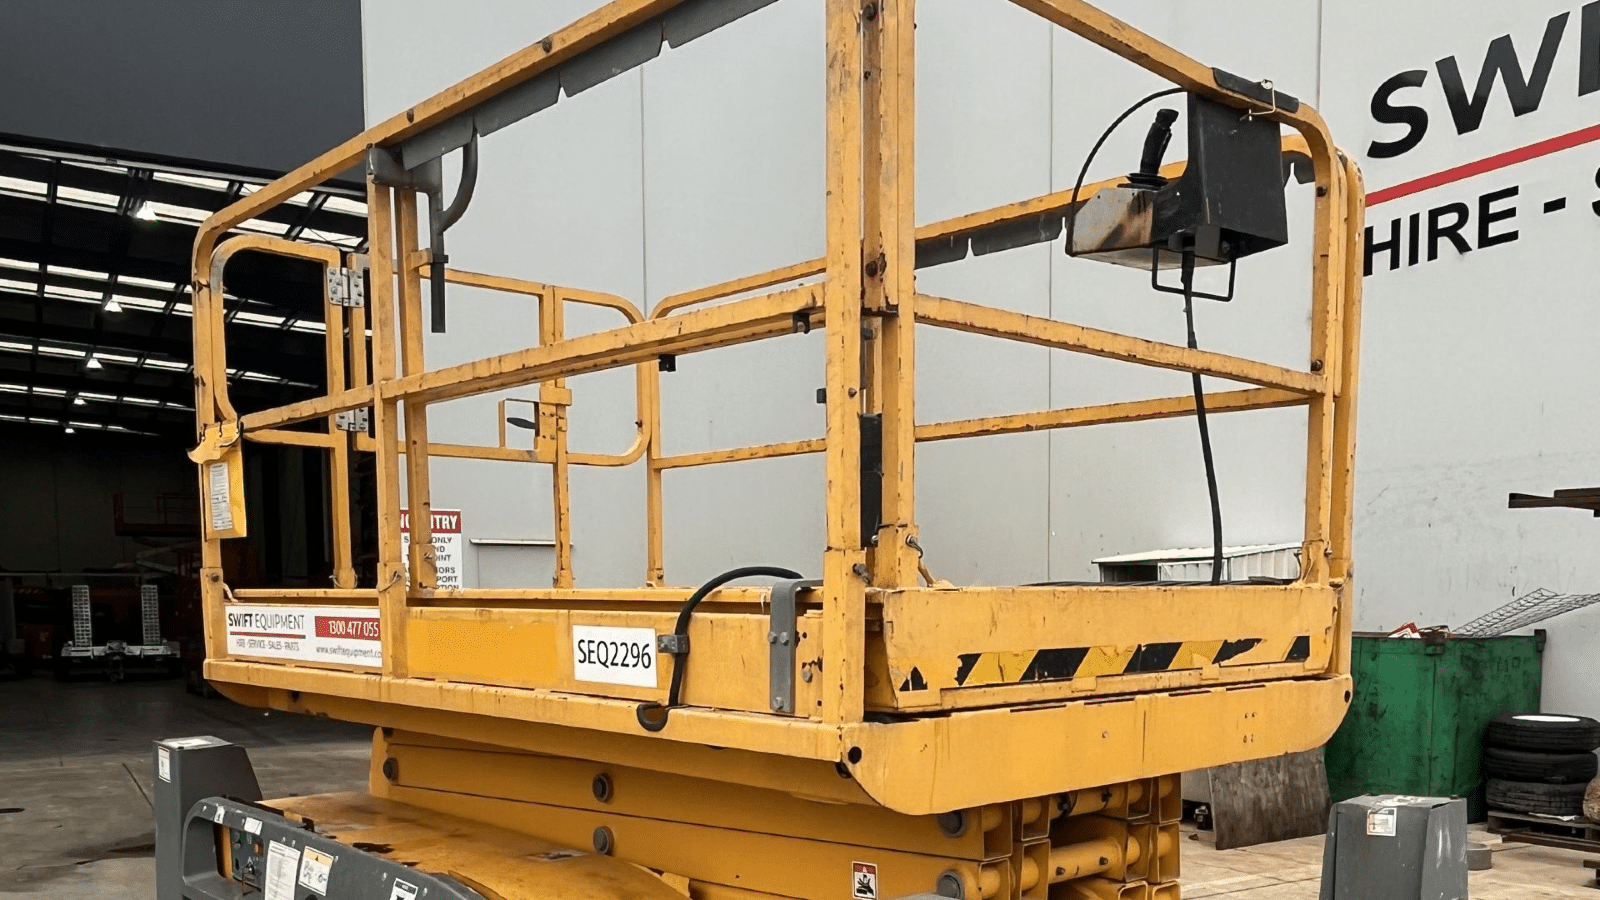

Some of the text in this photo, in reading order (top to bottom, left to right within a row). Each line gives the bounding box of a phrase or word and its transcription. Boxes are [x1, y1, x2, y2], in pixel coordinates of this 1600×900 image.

[1363, 185, 1519, 277] HIRE
[228, 612, 305, 631] SWIFT EQUIPMENT
[328, 620, 379, 637] 1300 477 055
[577, 639, 652, 669] SEQ2296
